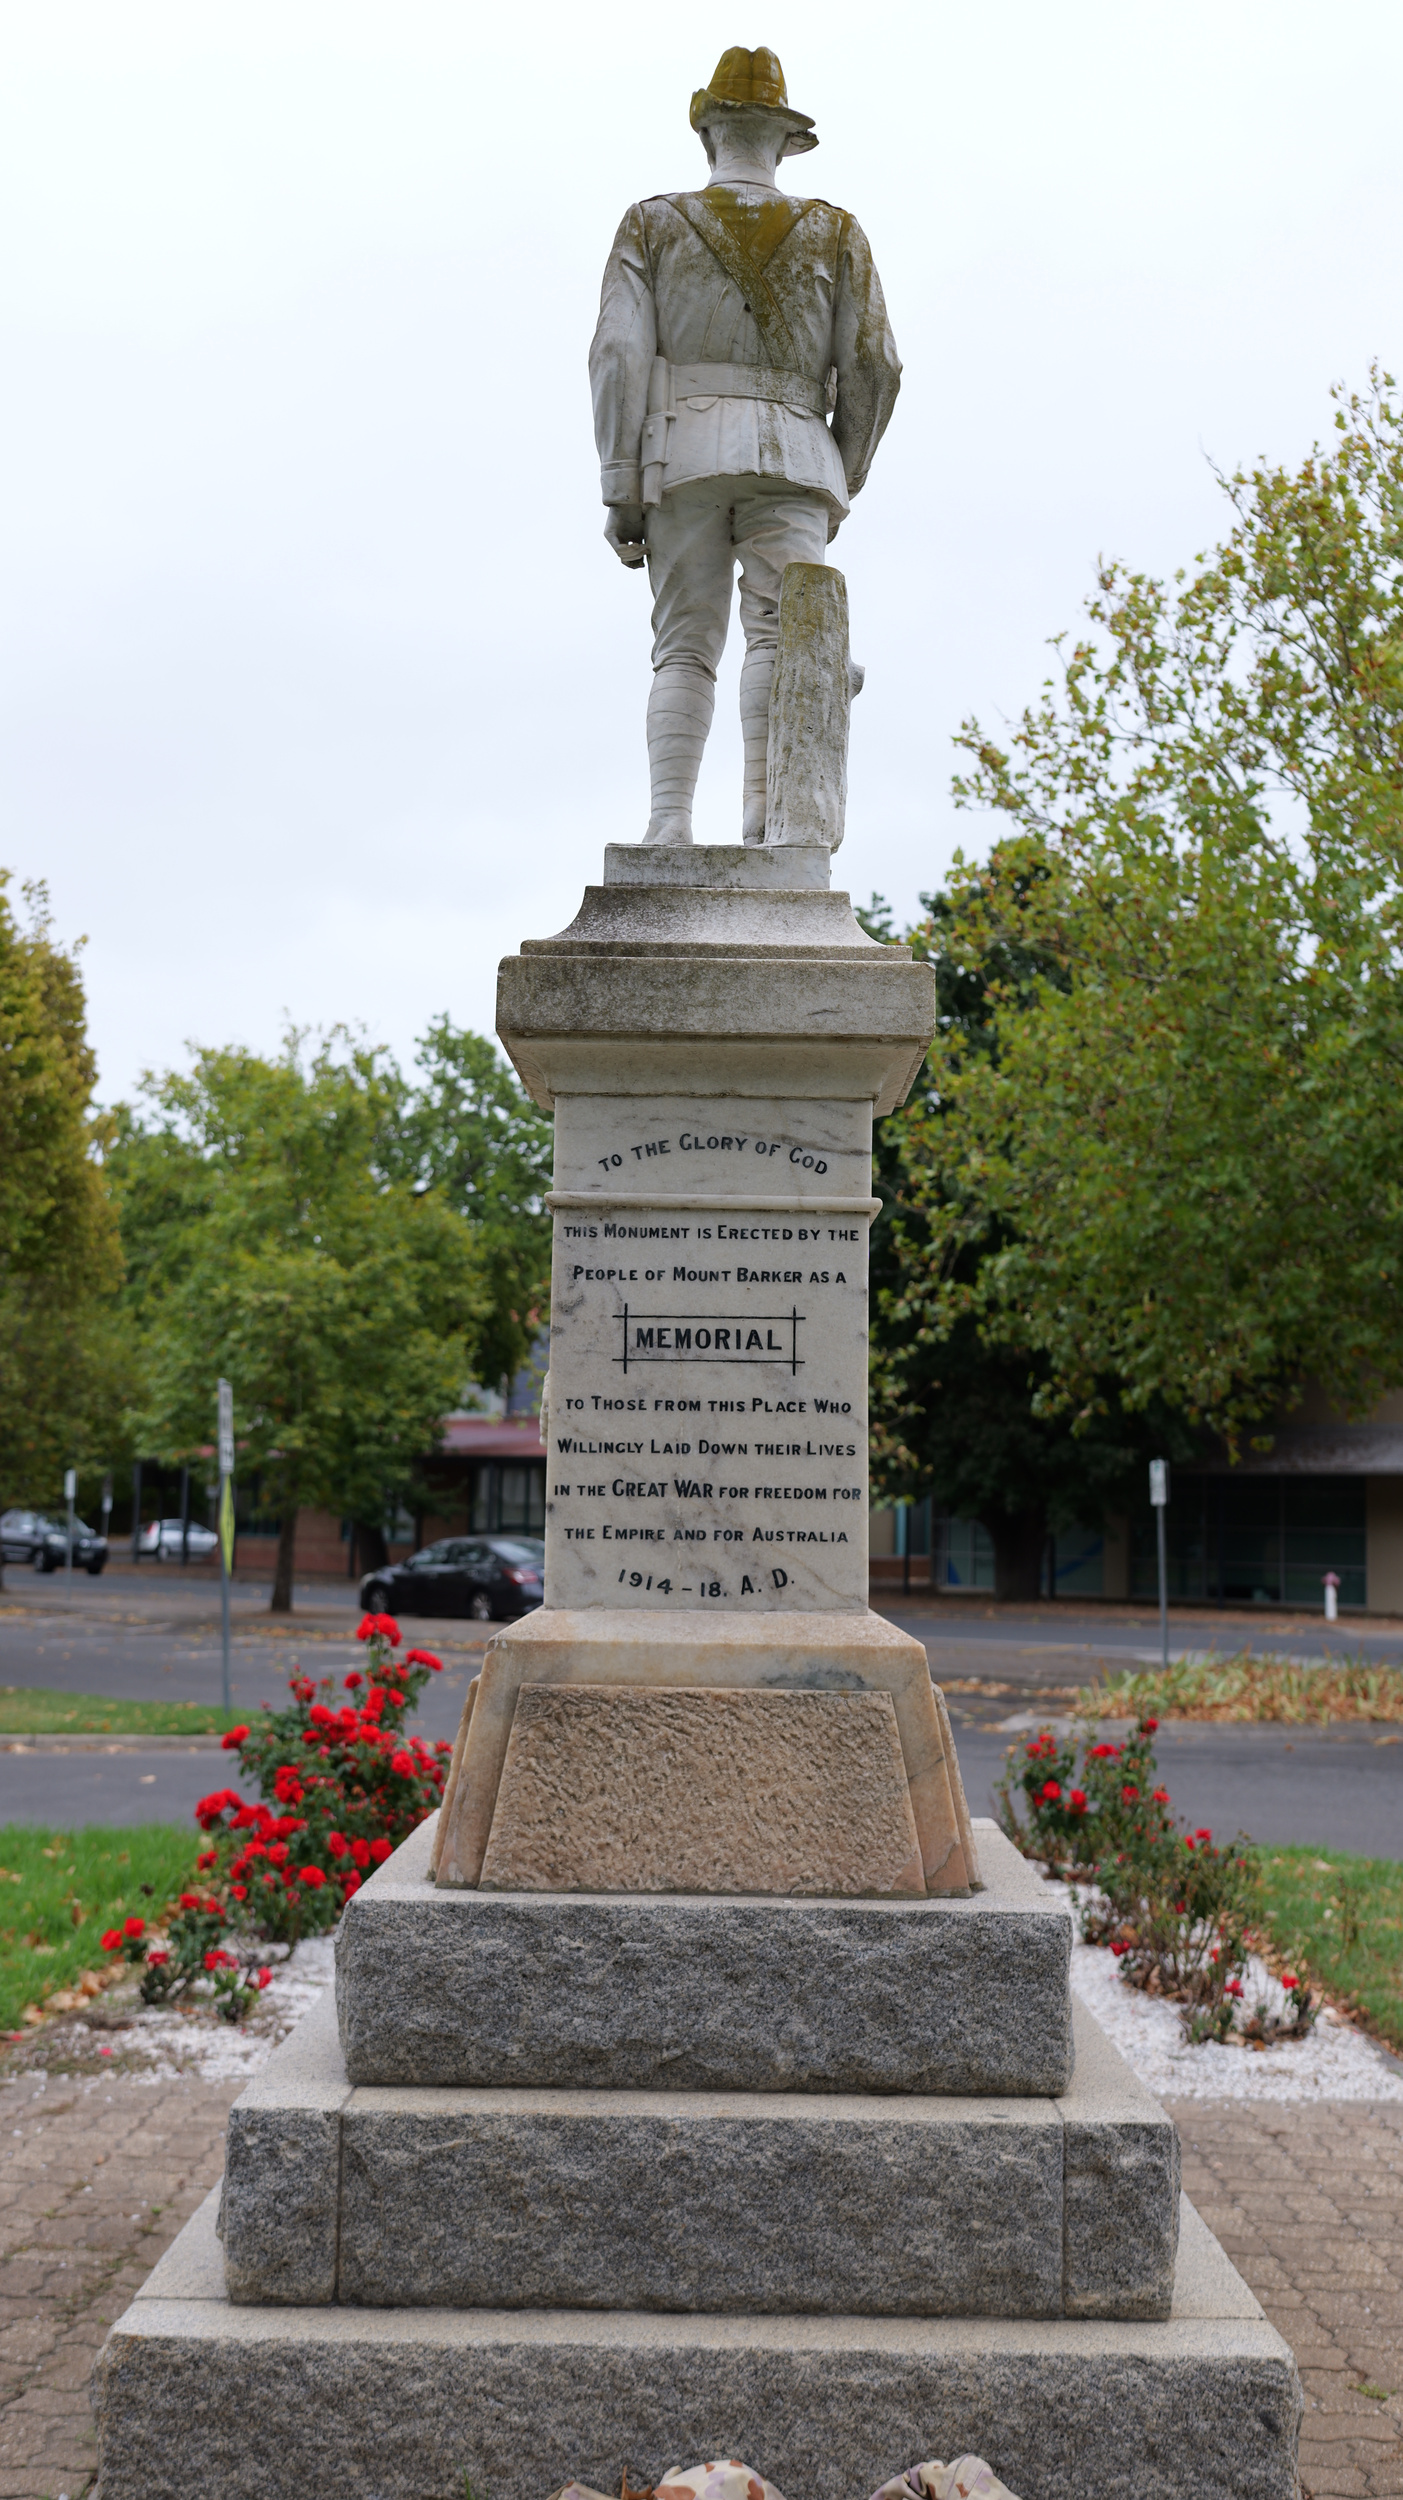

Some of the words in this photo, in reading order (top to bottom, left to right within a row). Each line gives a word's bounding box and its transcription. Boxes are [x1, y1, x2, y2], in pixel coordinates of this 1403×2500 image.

[598, 1154, 622, 1171] TO
[631, 1140, 671, 1160] THE
[679, 1133, 748, 1151] GLORY
[755, 1141, 781, 1156] OF
[789, 1147, 828, 1174] GOD
[564, 1225, 598, 1238] THIS
[604, 1223, 690, 1238] MONUMENT
[698, 1228, 711, 1239] IS
[718, 1225, 793, 1240] ERECTED
[798, 1229, 820, 1240] BY
[828, 1230, 859, 1241] THE
[573, 1265, 638, 1280] PEOPLE
[645, 1270, 665, 1281] OF
[673, 1267, 731, 1282] MOUNT
[737, 1268, 802, 1283] BARKER
[809, 1271, 829, 1283] AS
[836, 1272, 846, 1283] A
[636, 1327, 782, 1350] MEMORIAL
[566, 1399, 584, 1410] TO
[591, 1396, 647, 1410] THOSE
[655, 1400, 701, 1411] FROM
[708, 1401, 745, 1412] THIS
[752, 1398, 806, 1412] PLACE
[814, 1399, 851, 1413] WHO
[558, 1438, 643, 1453] WILLINGLY
[651, 1439, 691, 1454] LAID
[699, 1440, 747, 1455] DOWN
[755, 1444, 801, 1455] THEIR
[807, 1441, 855, 1456] LIVES
[555, 1485, 570, 1496] IN
[577, 1485, 606, 1496] THE
[612, 1479, 668, 1497] GREAT
[674, 1479, 713, 1498] WAR
[719, 1487, 749, 1498] FOR
[755, 1487, 826, 1499] FREEDOM
[564, 1528, 595, 1539] THE
[603, 1525, 665, 1540] EMPIRE
[674, 1529, 706, 1541] AND
[714, 1529, 743, 1541] FOR
[752, 1527, 848, 1542] AUSTRALIA
